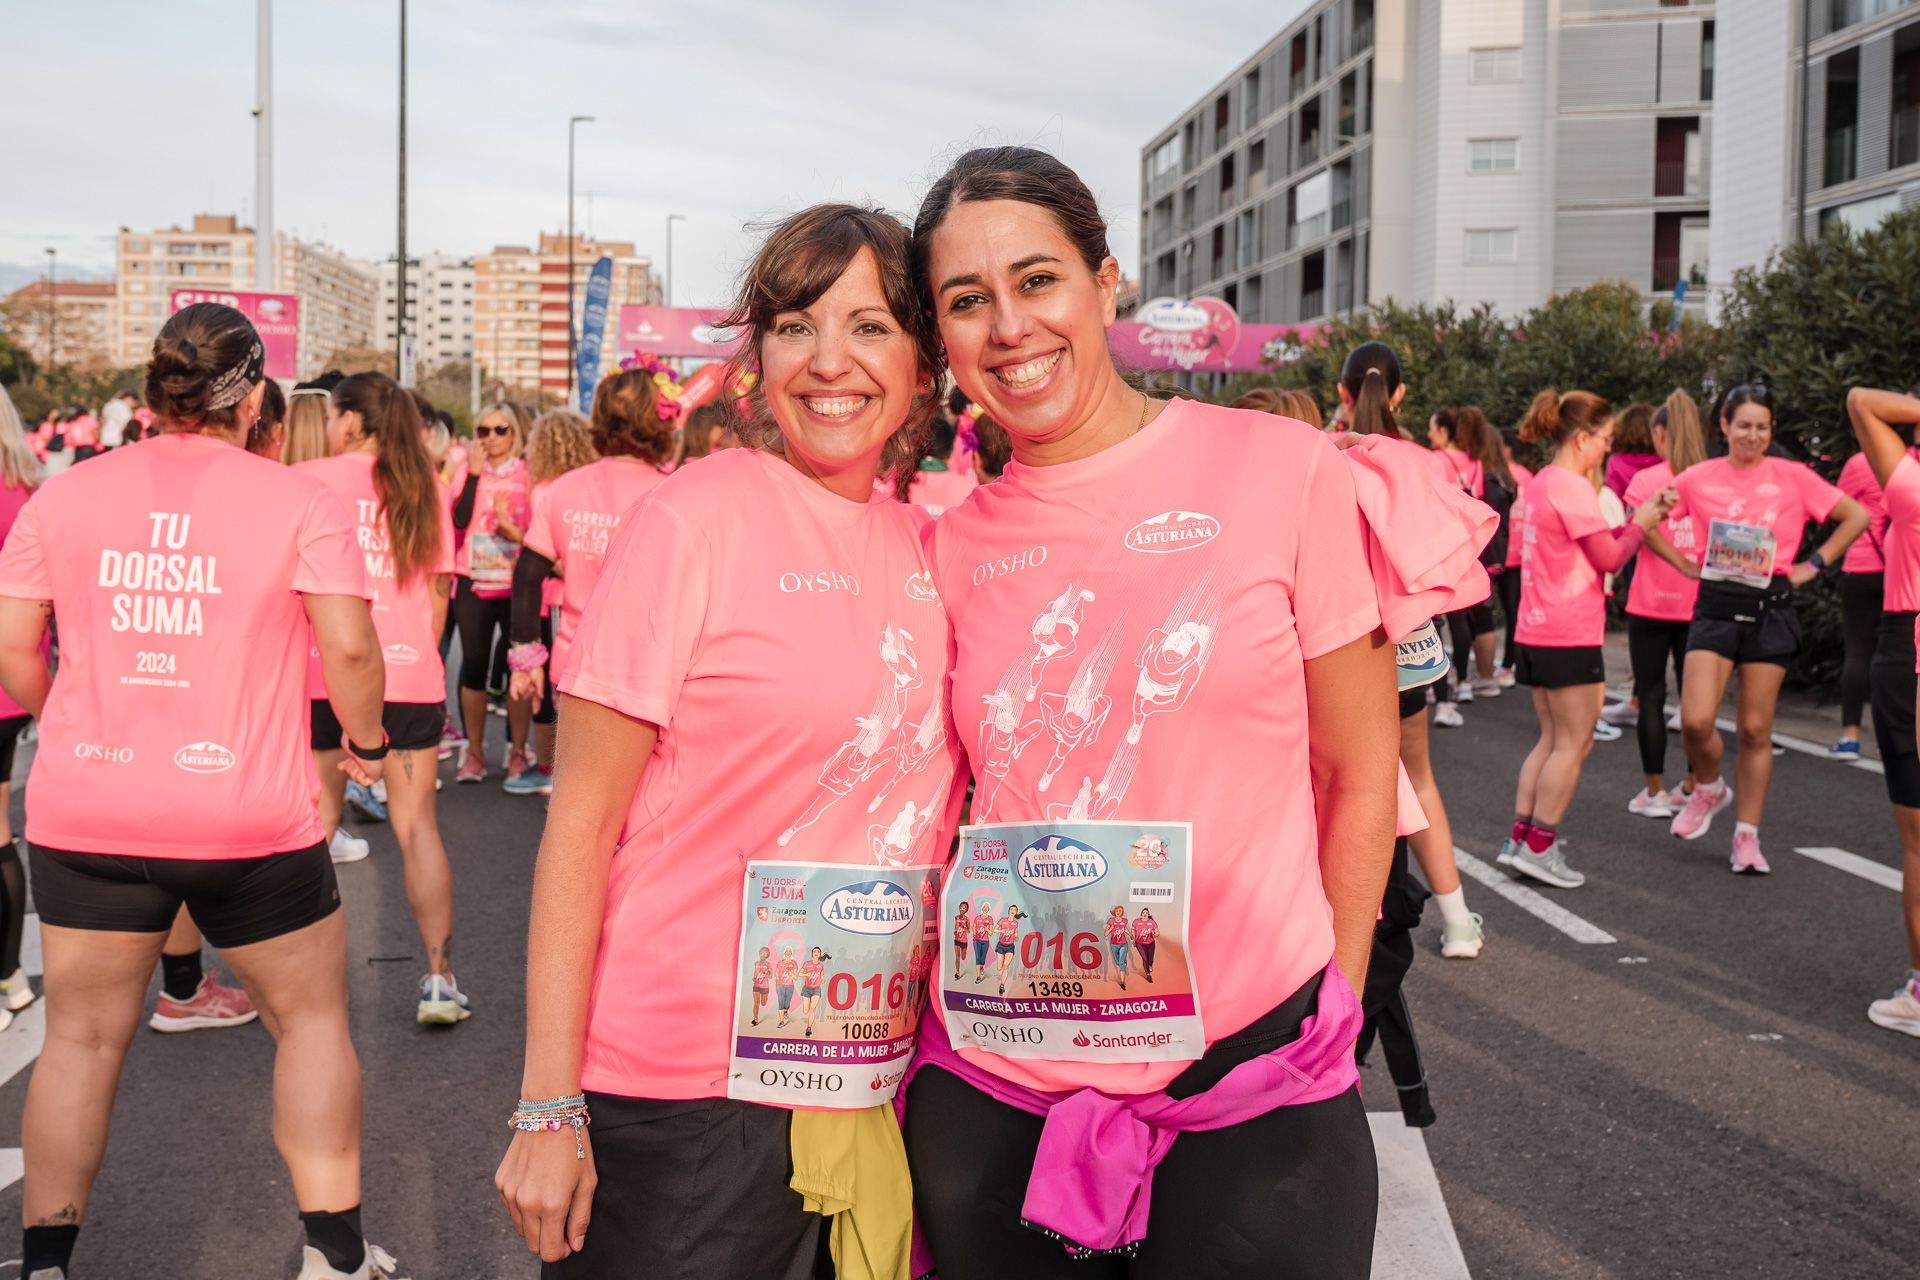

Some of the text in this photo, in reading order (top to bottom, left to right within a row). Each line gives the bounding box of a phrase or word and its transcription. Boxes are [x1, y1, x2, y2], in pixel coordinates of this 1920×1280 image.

[149, 512, 191, 550] TU
[1131, 526, 1213, 546] ASTURIANA
[98, 549, 222, 594] DORSAL
[973, 545, 1048, 586] OYSHO
[780, 571, 860, 596] OYSHO
[111, 593, 203, 636] SUMA
[136, 651, 176, 674] 2024
[972, 849, 1008, 861] SUMA
[976, 865, 1009, 875] Zaragoza
[1023, 856, 1099, 878] ASTURIANA
[761, 877, 805, 887] TU DORS
[761, 886, 804, 900] SUMA
[846, 897, 882, 905] CENTRAL
[772, 906, 807, 917] Zaragoza
[828, 898, 910, 922] ASTURIANA
[1020, 931, 1103, 971] 016
[827, 972, 906, 1012] 016
[1028, 981, 1084, 998] 13489
[966, 998, 1168, 1016] CARRERA DE LA MUJER ZARAGOZA
[841, 1022, 889, 1040] 10088
[972, 1021, 1044, 1045] OYSHO
[1093, 1031, 1173, 1049] Santander
[763, 1042, 819, 1057] CARRERA
[822, 1045, 838, 1058] DE
[841, 1045, 855, 1058] LA
[858, 1044, 888, 1058] MUJER
[760, 1069, 844, 1092] OYSHO
